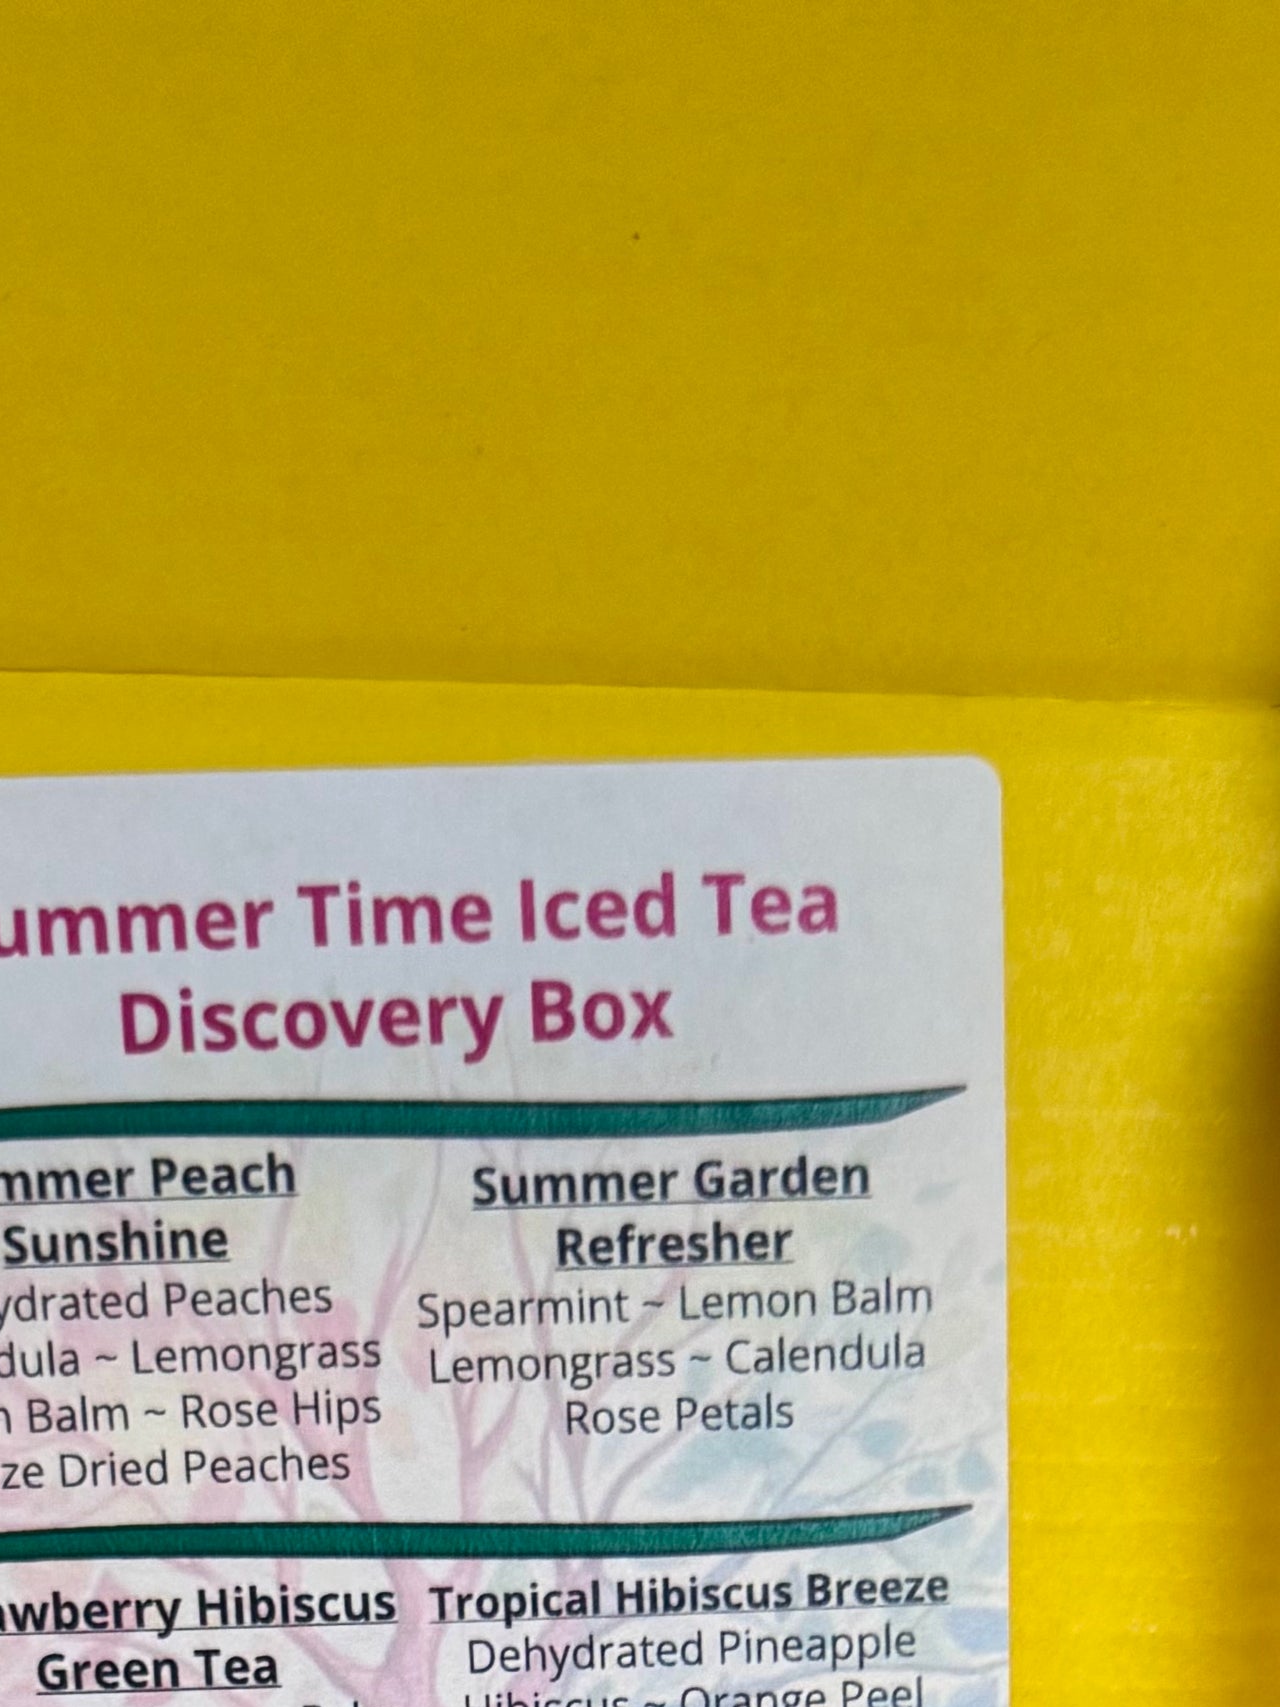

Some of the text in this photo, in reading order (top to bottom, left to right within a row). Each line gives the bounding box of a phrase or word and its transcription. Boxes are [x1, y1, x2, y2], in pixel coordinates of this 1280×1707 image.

[295, 879, 494, 949] Time
[518, 869, 677, 943] Iced
[700, 871, 839, 937] Tea
[118, 978, 675, 1066] Discovery Box
[150, 1154, 296, 1200] Peach
[472, 1156, 871, 1208] Summer Garden
[2, 1218, 229, 1265] Sunshine
[556, 1219, 794, 1267] Refresher
[162, 1275, 334, 1319] Peaches
[416, 1285, 631, 1341] Spearmint
[678, 1283, 818, 1322] Lemon
[831, 1274, 934, 1317] Balm
[130, 1337, 383, 1383] Lemongrass
[428, 1346, 677, 1392] Lemongrass
[724, 1330, 927, 1376] Calendula
[25, 1393, 131, 1435] Balm
[180, 1392, 280, 1431] Rose
[291, 1388, 383, 1437] Hips
[564, 1390, 795, 1438] Rose Petals
[58, 1447, 170, 1489] Dried
[182, 1443, 352, 1486] Peaches
[195, 1584, 397, 1631] Hibiscus
[430, 1571, 949, 1622] Tropical Hibiscus Breeze
[37, 1648, 280, 1694] Green Tea
[467, 1619, 917, 1684] Dehydrated Pineapple
